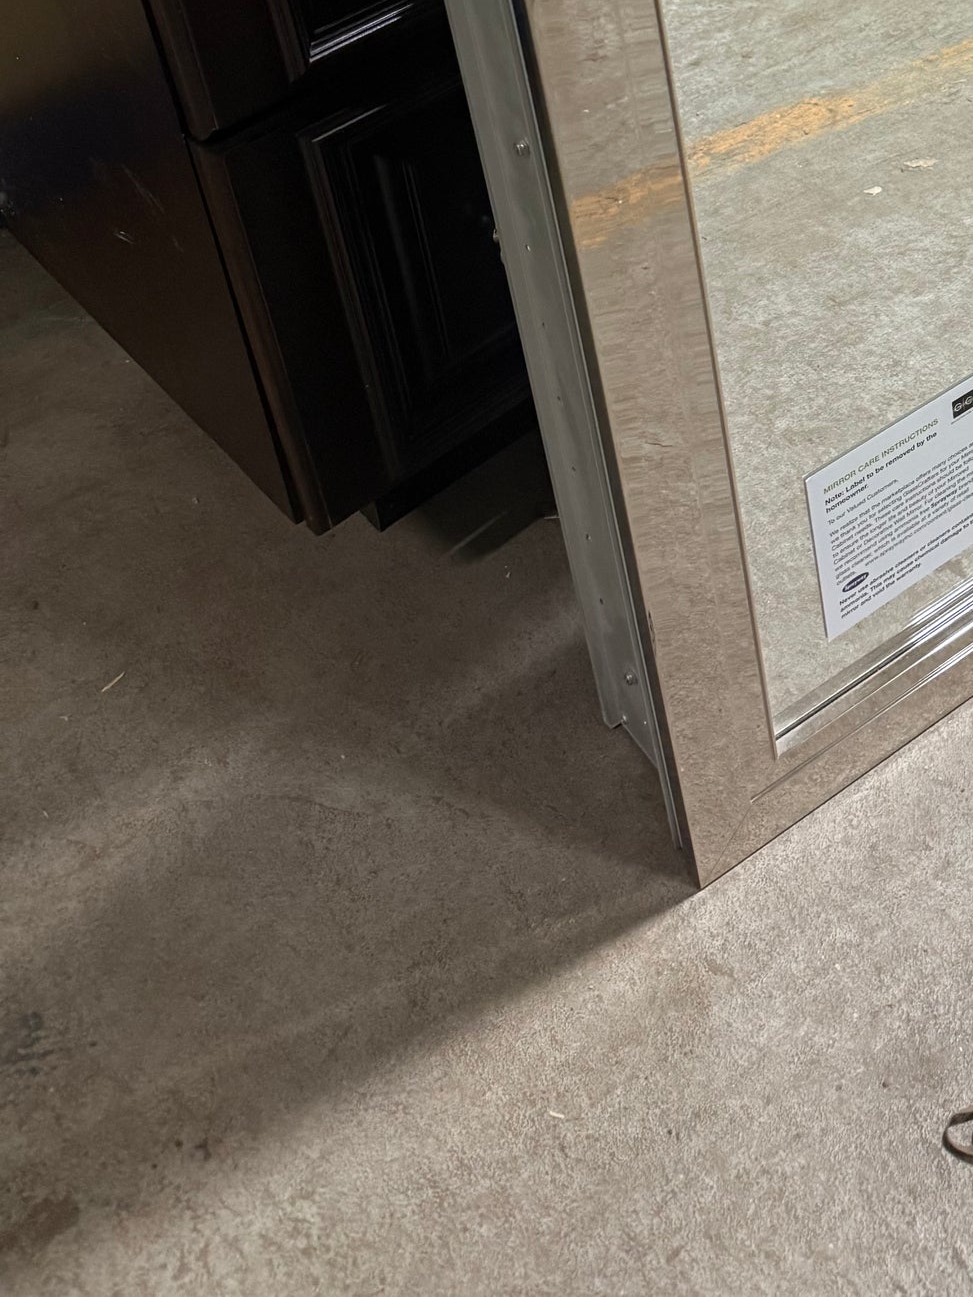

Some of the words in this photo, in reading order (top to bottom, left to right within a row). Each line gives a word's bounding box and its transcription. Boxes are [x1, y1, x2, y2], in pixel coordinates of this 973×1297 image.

[823, 470, 856, 495] MIRROR
[858, 455, 880, 474] CARE
[881, 418, 938, 459] INSTRUCTIONS
[825, 490, 844, 507] Note:
[846, 476, 865, 493] Label
[867, 472, 874, 480] to
[875, 465, 884, 475] be
[885, 445, 915, 468] removed
[916, 439, 925, 449] by
[926, 431, 937, 442] the
[826, 483, 869, 514] homeowner.
